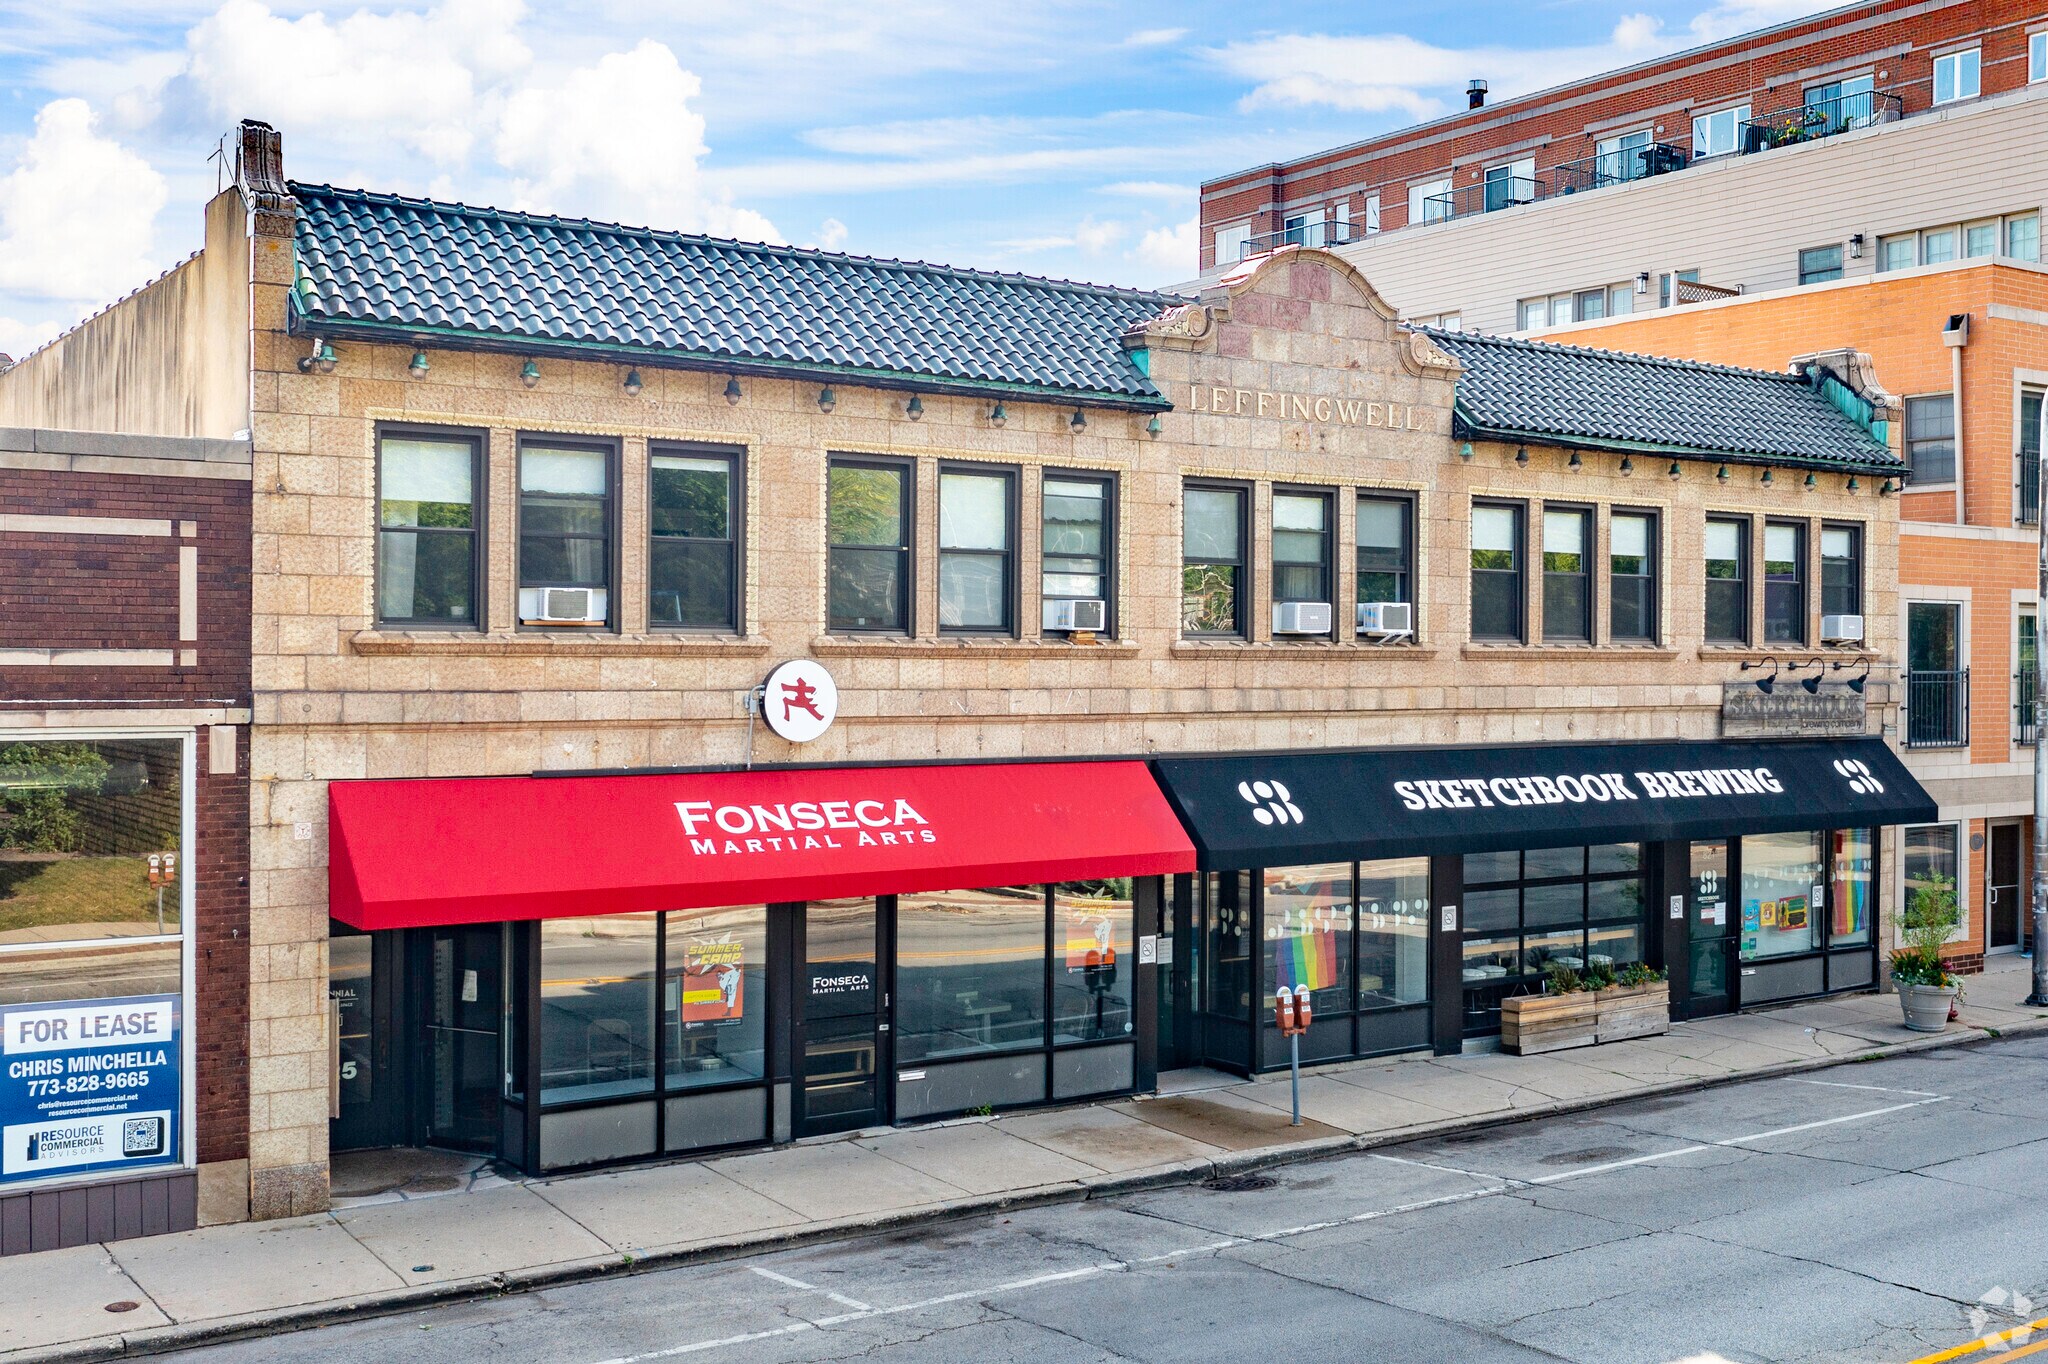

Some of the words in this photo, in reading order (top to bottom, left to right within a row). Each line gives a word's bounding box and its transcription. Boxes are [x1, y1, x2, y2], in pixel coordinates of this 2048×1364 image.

[1190, 385, 1423, 431] LEFFINGWELL
[1730, 694, 1863, 716] SKETCHBOOK
[1831, 719, 1862, 730] company
[1393, 773, 1637, 810] SKETCHBOOK
[1634, 767, 1784, 799] BREWING
[673, 798, 929, 836] FONSECA
[689, 834, 842, 855] MARTIAL
[858, 829, 937, 847] ARTS
[688, 943, 742, 955] SUMMER
[700, 952, 742, 965] CAMP
[812, 975, 869, 988] FONSECA
[812, 987, 845, 995] MARTIAL
[19, 1018, 69, 1044] FOR
[80, 1011, 158, 1039] LEASE
[9, 1058, 64, 1079] CHRIS
[68, 1050, 167, 1074] MINCHELLA
[27, 1071, 150, 1097] 773-828-9665
[37, 1093, 139, 1110] chris@resourcecommercial.net
[48, 1102, 128, 1117] resourcecommercial.net
[41, 1125, 105, 1142] RESOURCE
[40, 1137, 105, 1152] COMMERCIAL
[40, 1146, 105, 1160] ADVISORS
